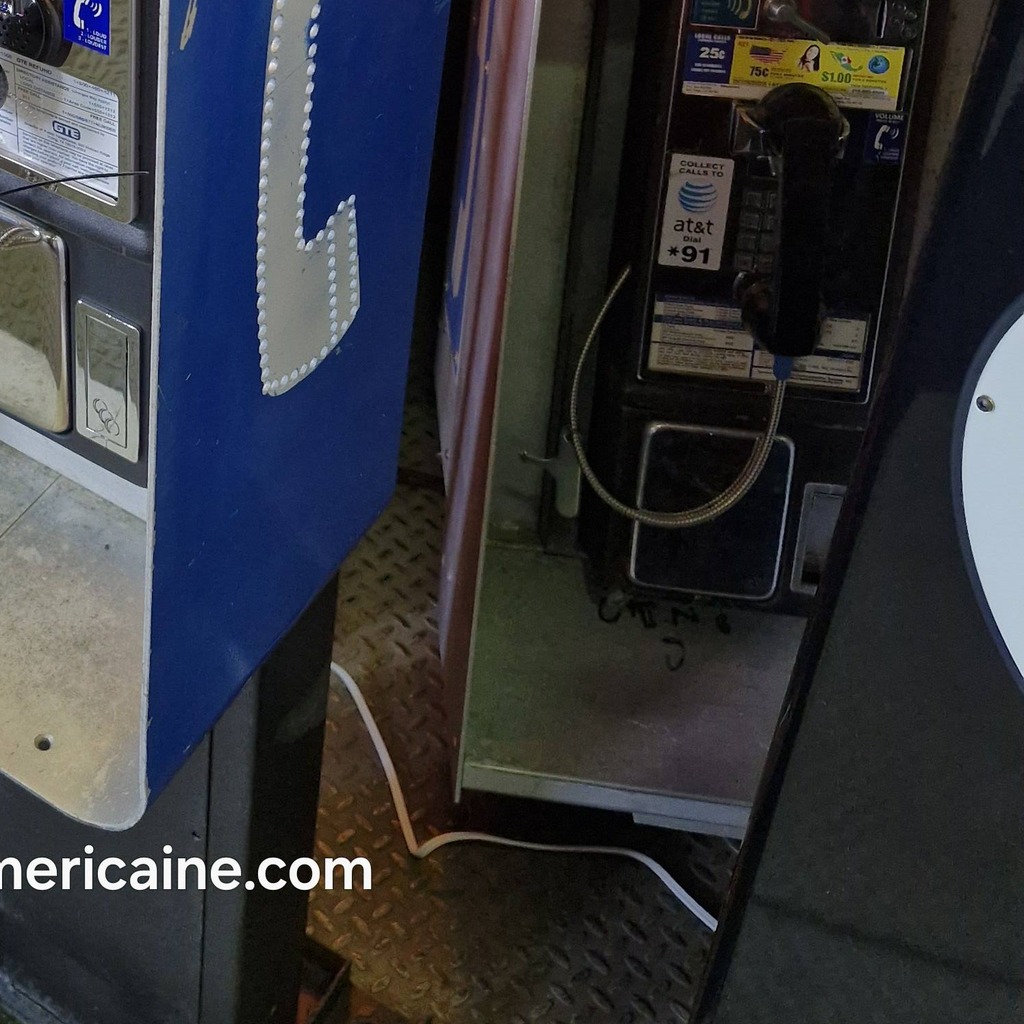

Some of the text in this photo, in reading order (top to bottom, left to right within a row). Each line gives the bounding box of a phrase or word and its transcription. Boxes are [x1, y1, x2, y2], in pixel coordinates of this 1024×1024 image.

[87, 34, 107, 45] LOUDER
[93, 30, 107, 39] LOUD
[821, 71, 852, 84] $1.00
[56, 123, 79, 138] GTE
[680, 160, 725, 170] COLLECT
[679, 167, 724, 178] CALLS TO
[674, 217, 714, 235] at&t
